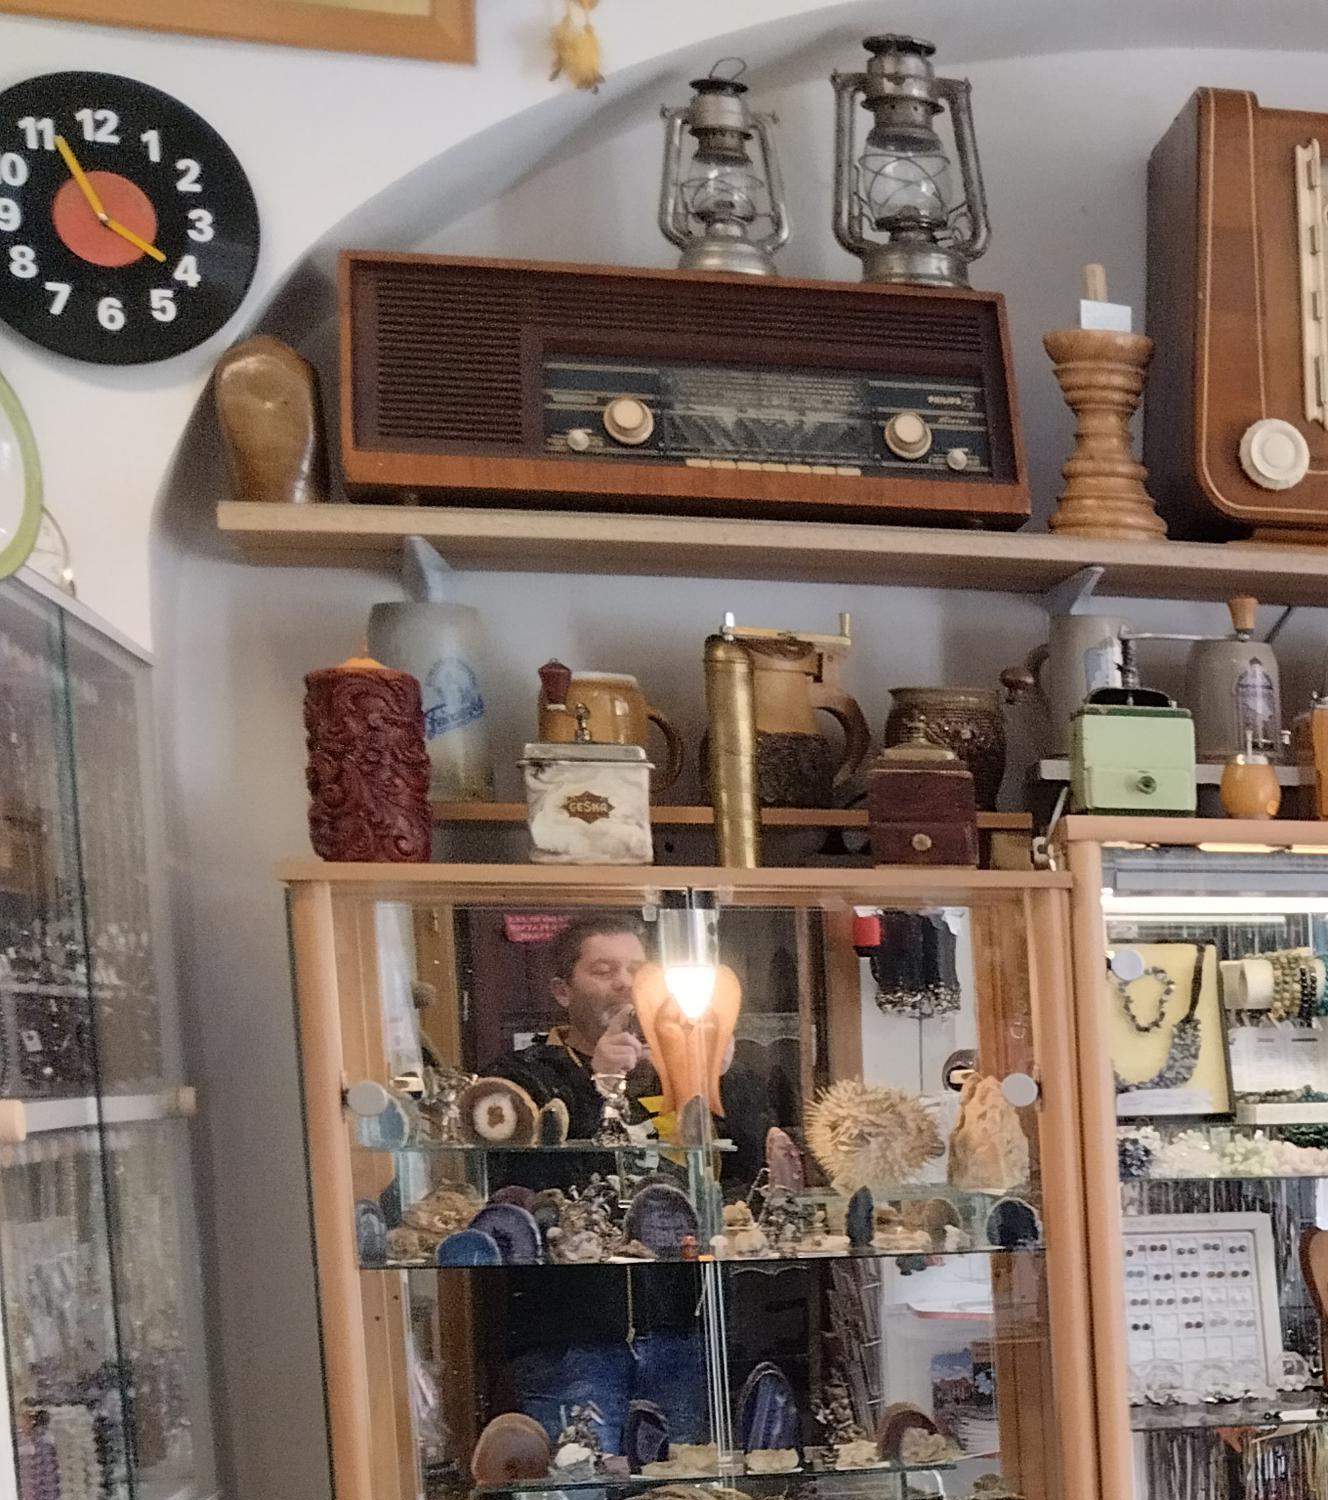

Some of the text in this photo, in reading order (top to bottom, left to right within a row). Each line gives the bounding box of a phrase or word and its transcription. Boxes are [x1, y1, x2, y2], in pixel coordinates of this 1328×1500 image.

[18, 116, 56, 150] 11
[75, 109, 120, 144] 12
[140, 130, 161, 163] 1
[0, 152, 28, 187] 0
[175, 158, 202, 192] 2
[186, 209, 215, 243] 3
[9, 245, 38, 279] 8
[173, 255, 201, 288] 4
[44, 281, 71, 316] 7
[97, 297, 126, 331] 6
[150, 288, 177, 322] 5
